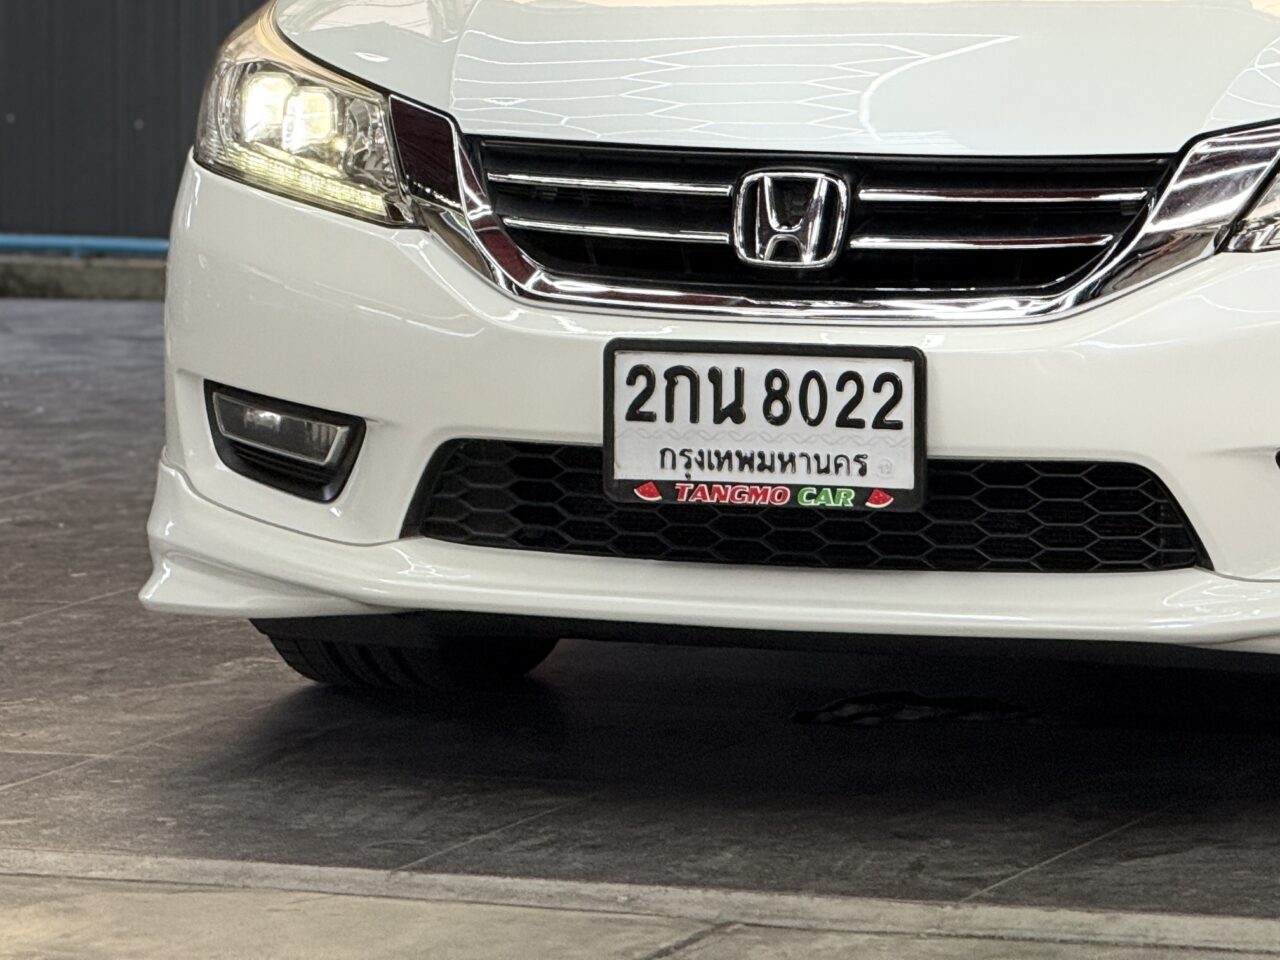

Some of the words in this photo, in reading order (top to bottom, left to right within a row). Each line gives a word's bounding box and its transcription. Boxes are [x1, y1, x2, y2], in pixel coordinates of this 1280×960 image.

[624, 363, 747, 426] 2กน
[762, 367, 905, 431] 8022
[659, 445, 870, 481] กรุงเทพมหานคร
[674, 482, 792, 506] TANGMO
[796, 486, 857, 508] CAR
